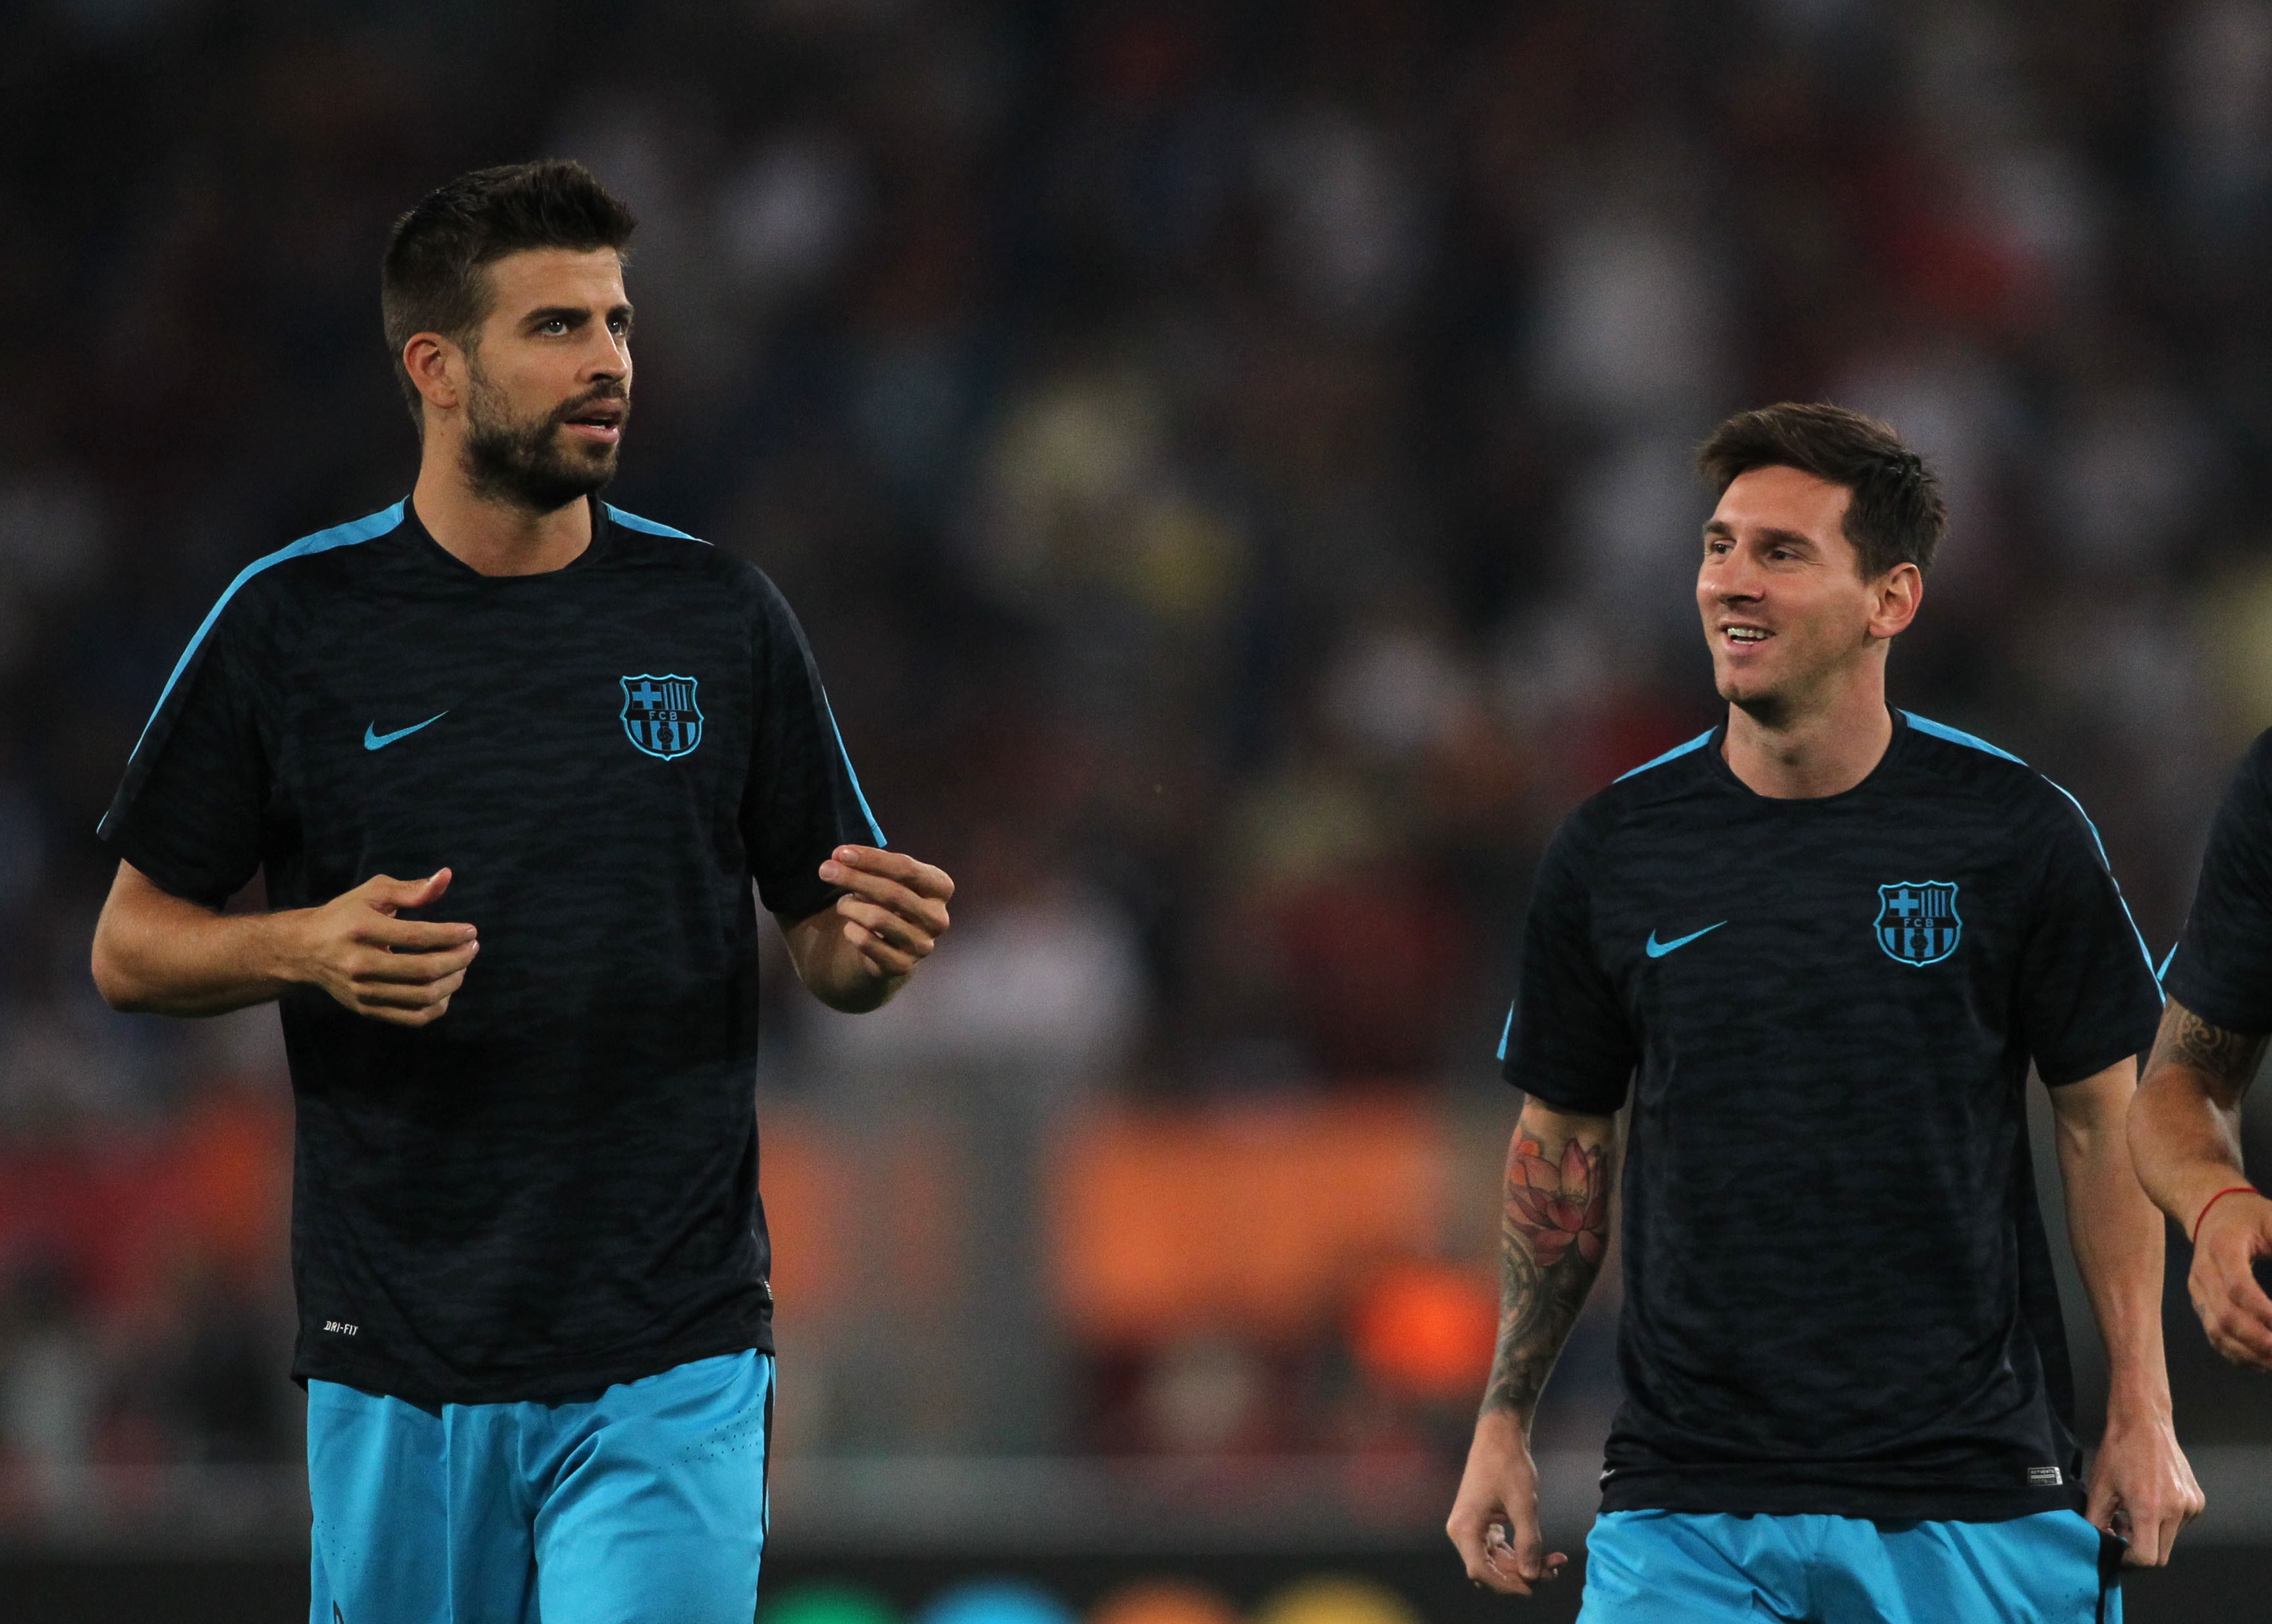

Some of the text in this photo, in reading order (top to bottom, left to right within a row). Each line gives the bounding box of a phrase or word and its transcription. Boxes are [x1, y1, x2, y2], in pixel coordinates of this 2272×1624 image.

[649, 711, 677, 721] FCB
[1904, 918, 1934, 927] FCB
[323, 1320, 358, 1336] DRI-FIT
